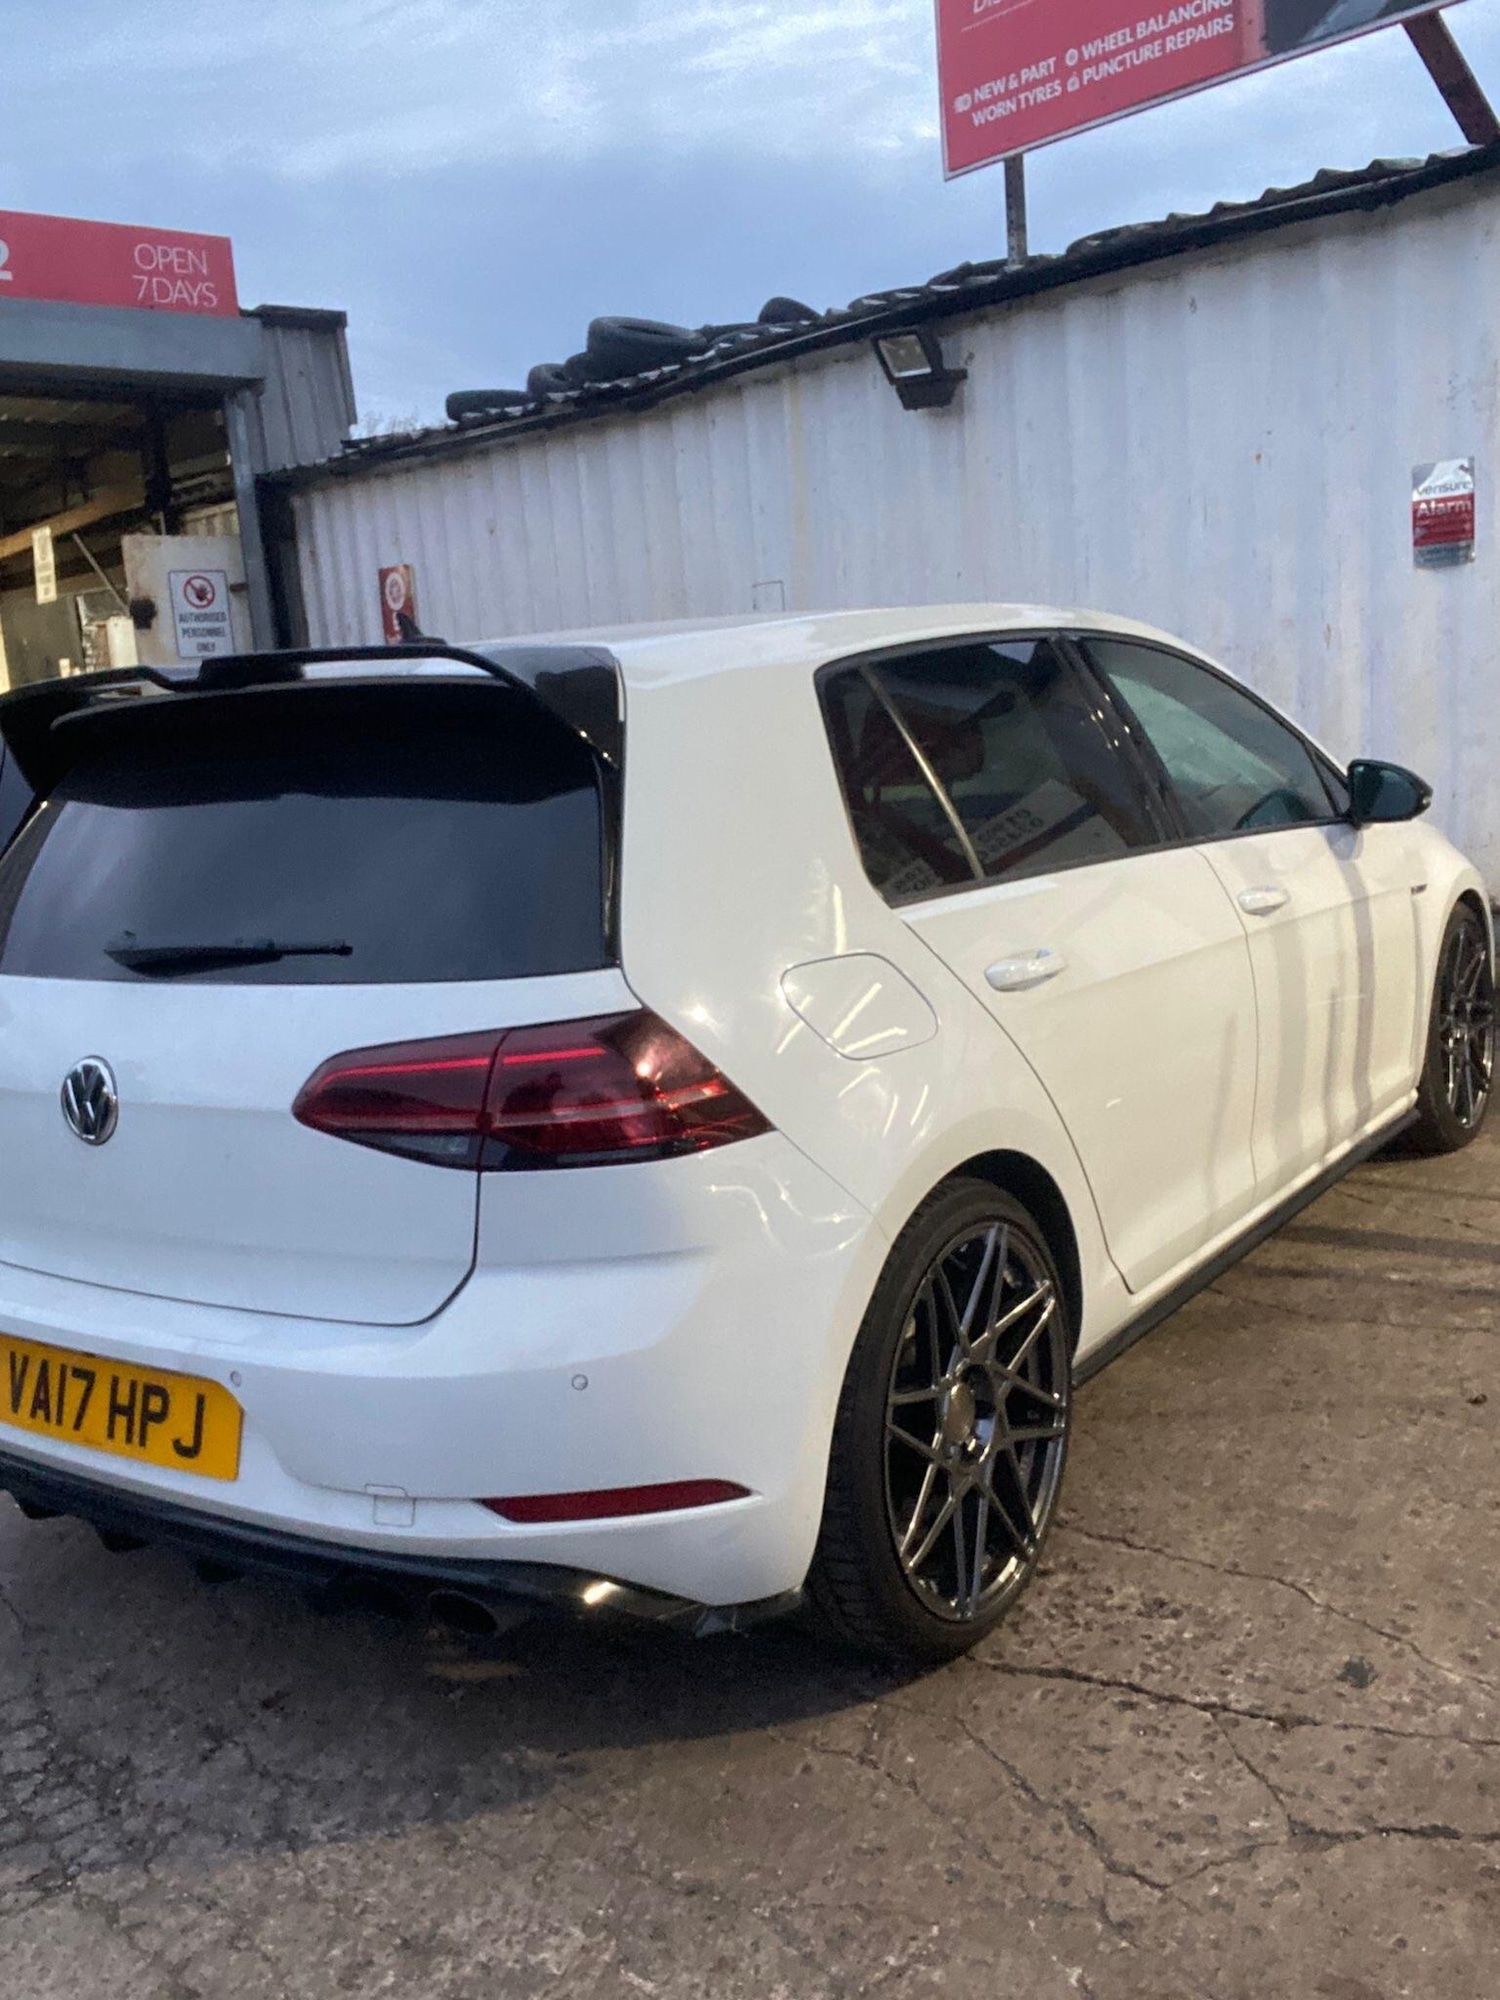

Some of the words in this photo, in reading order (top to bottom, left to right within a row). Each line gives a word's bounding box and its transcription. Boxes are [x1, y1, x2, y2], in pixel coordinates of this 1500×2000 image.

[1081, 28, 1134, 60] WHEEL
[1083, 39, 1163, 85] PUNCTURE
[1165, 13, 1234, 53] REPAIRS
[972, 96, 1017, 127] WORN
[1018, 79, 1062, 109] TYRES
[974, 77, 1006, 103] NEW
[1008, 73, 1019, 90] &
[1020, 56, 1057, 85] PART
[133, 243, 208, 276] OPEN
[1418, 501, 1472, 517] Alarm
[9, 1351, 97, 1432] VA17
[106, 1375, 206, 1459] HPJ
